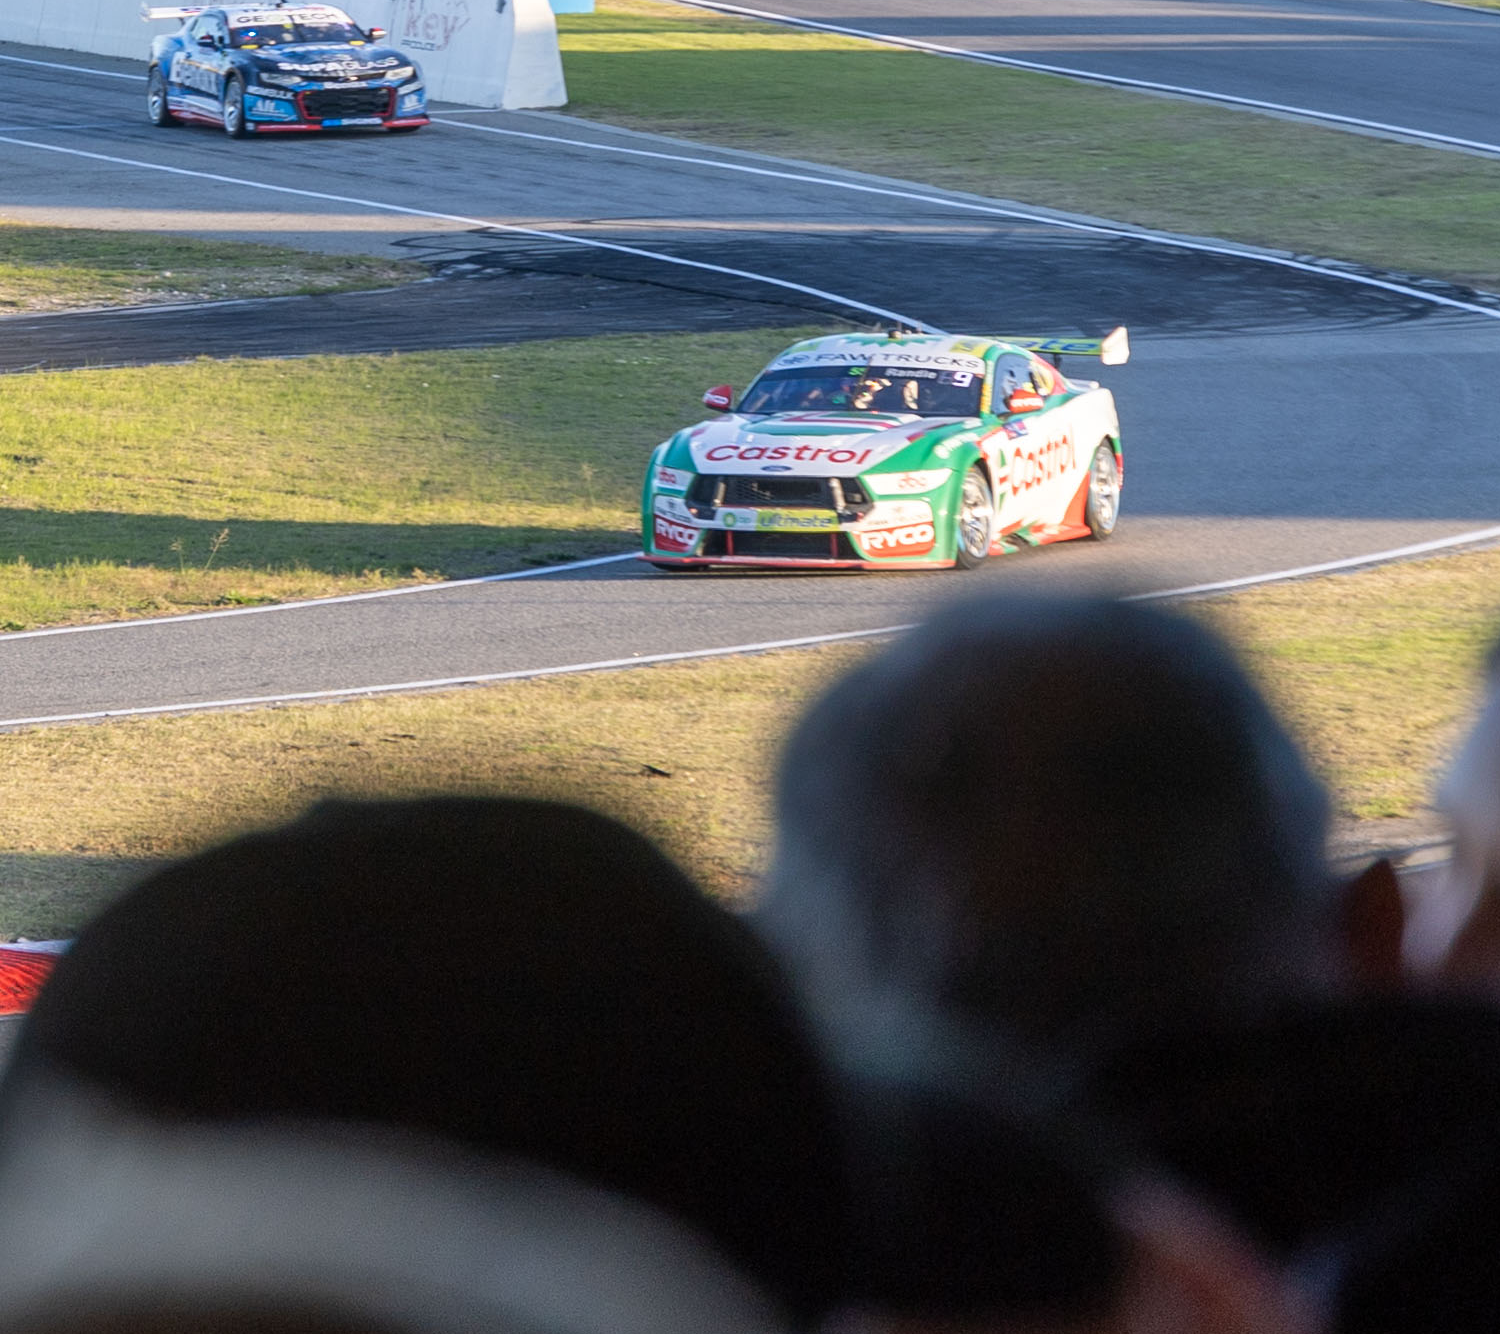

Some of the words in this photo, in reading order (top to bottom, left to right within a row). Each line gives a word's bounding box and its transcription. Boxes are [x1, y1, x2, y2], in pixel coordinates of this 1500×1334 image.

[814, 353, 876, 364] FAW
[883, 353, 979, 368] TRUCKS
[952, 371, 974, 387] 9
[705, 444, 873, 465] Castrol
[1012, 424, 1076, 496] Castrol
[760, 510, 833, 529] ultimate
[655, 518, 696, 543] RYCO
[860, 525, 934, 550] RYCO
